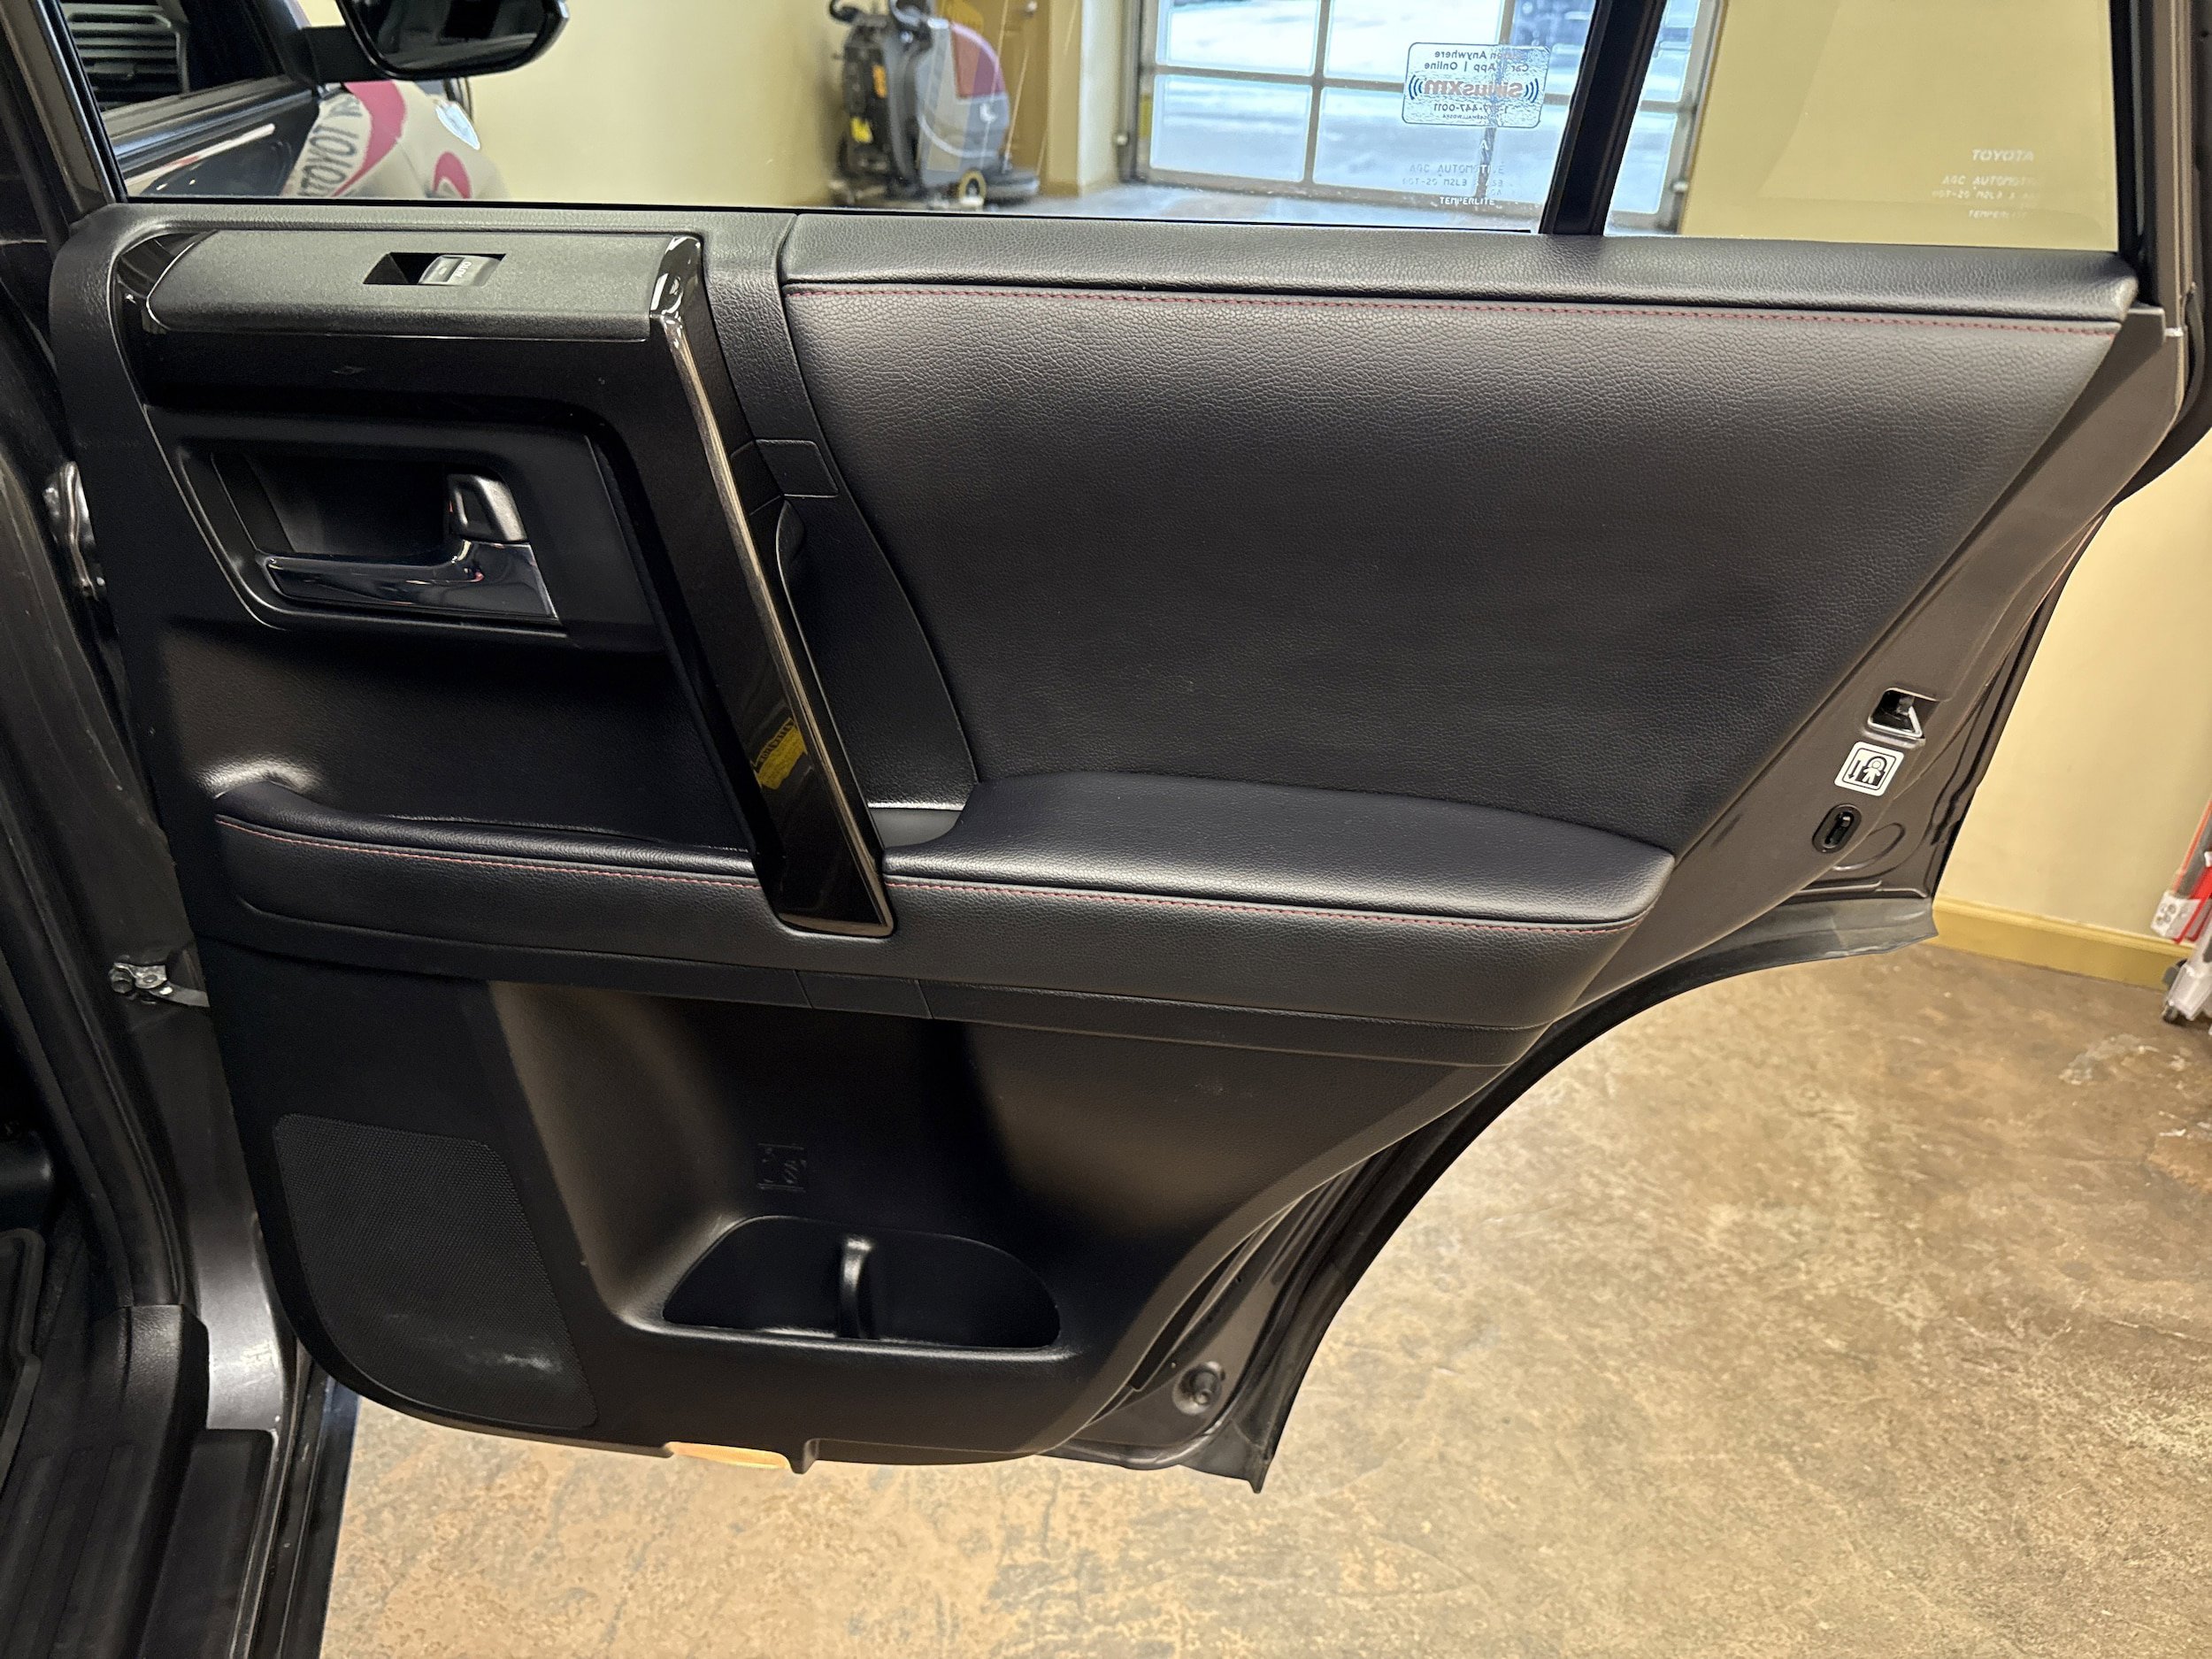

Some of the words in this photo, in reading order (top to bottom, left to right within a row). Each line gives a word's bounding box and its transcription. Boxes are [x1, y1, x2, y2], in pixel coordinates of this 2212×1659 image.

[1971, 149, 2033, 161] TOYOTA
[1437, 164, 1505, 174] AUTOMTIE
[1440, 196, 1495, 205] TEMPERLITE
[455, 261, 472, 278] AUTO
